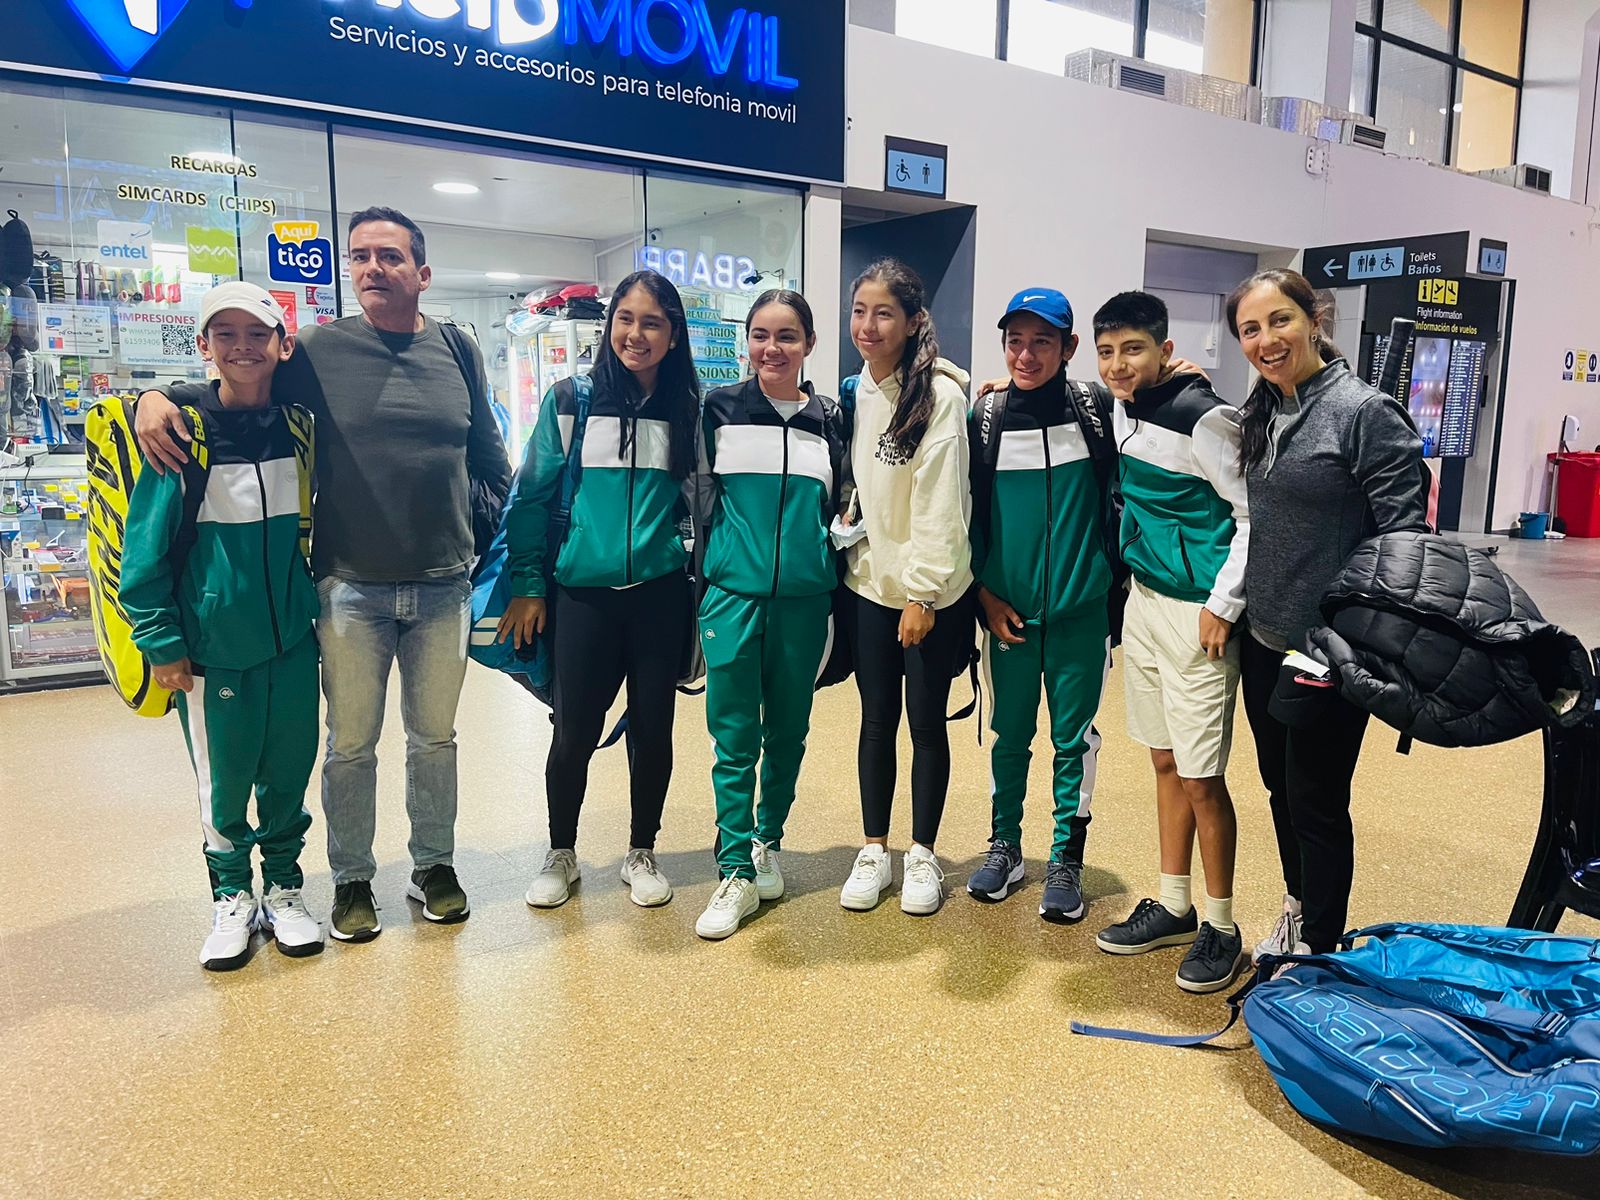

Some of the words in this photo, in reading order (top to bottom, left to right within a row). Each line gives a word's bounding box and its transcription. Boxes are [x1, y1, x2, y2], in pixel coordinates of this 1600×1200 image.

[329, 16, 447, 58] Servicios
[453, 43, 468, 66] y
[475, 48, 596, 87] accesorios
[603, 74, 649, 96] para
[656, 79, 741, 113] telefonia
[748, 100, 797, 123] movil
[171, 155, 257, 177] RECARGAS
[117, 184, 207, 206] SIMCARDS
[219, 195, 276, 216] (CHIPS)
[100, 243, 148, 260] entel
[277, 247, 323, 269] tigo
[1409, 252, 1437, 263] Toilets
[1408, 263, 1442, 275] Baños
[119, 312, 196, 325] IMPRESIONES
[1416, 306, 1432, 319] Flight
[1433, 308, 1463, 320] information
[1415, 320, 1450, 332] Información
[1451, 324, 1459, 333] de
[1460, 325, 1478, 335] vuelos
